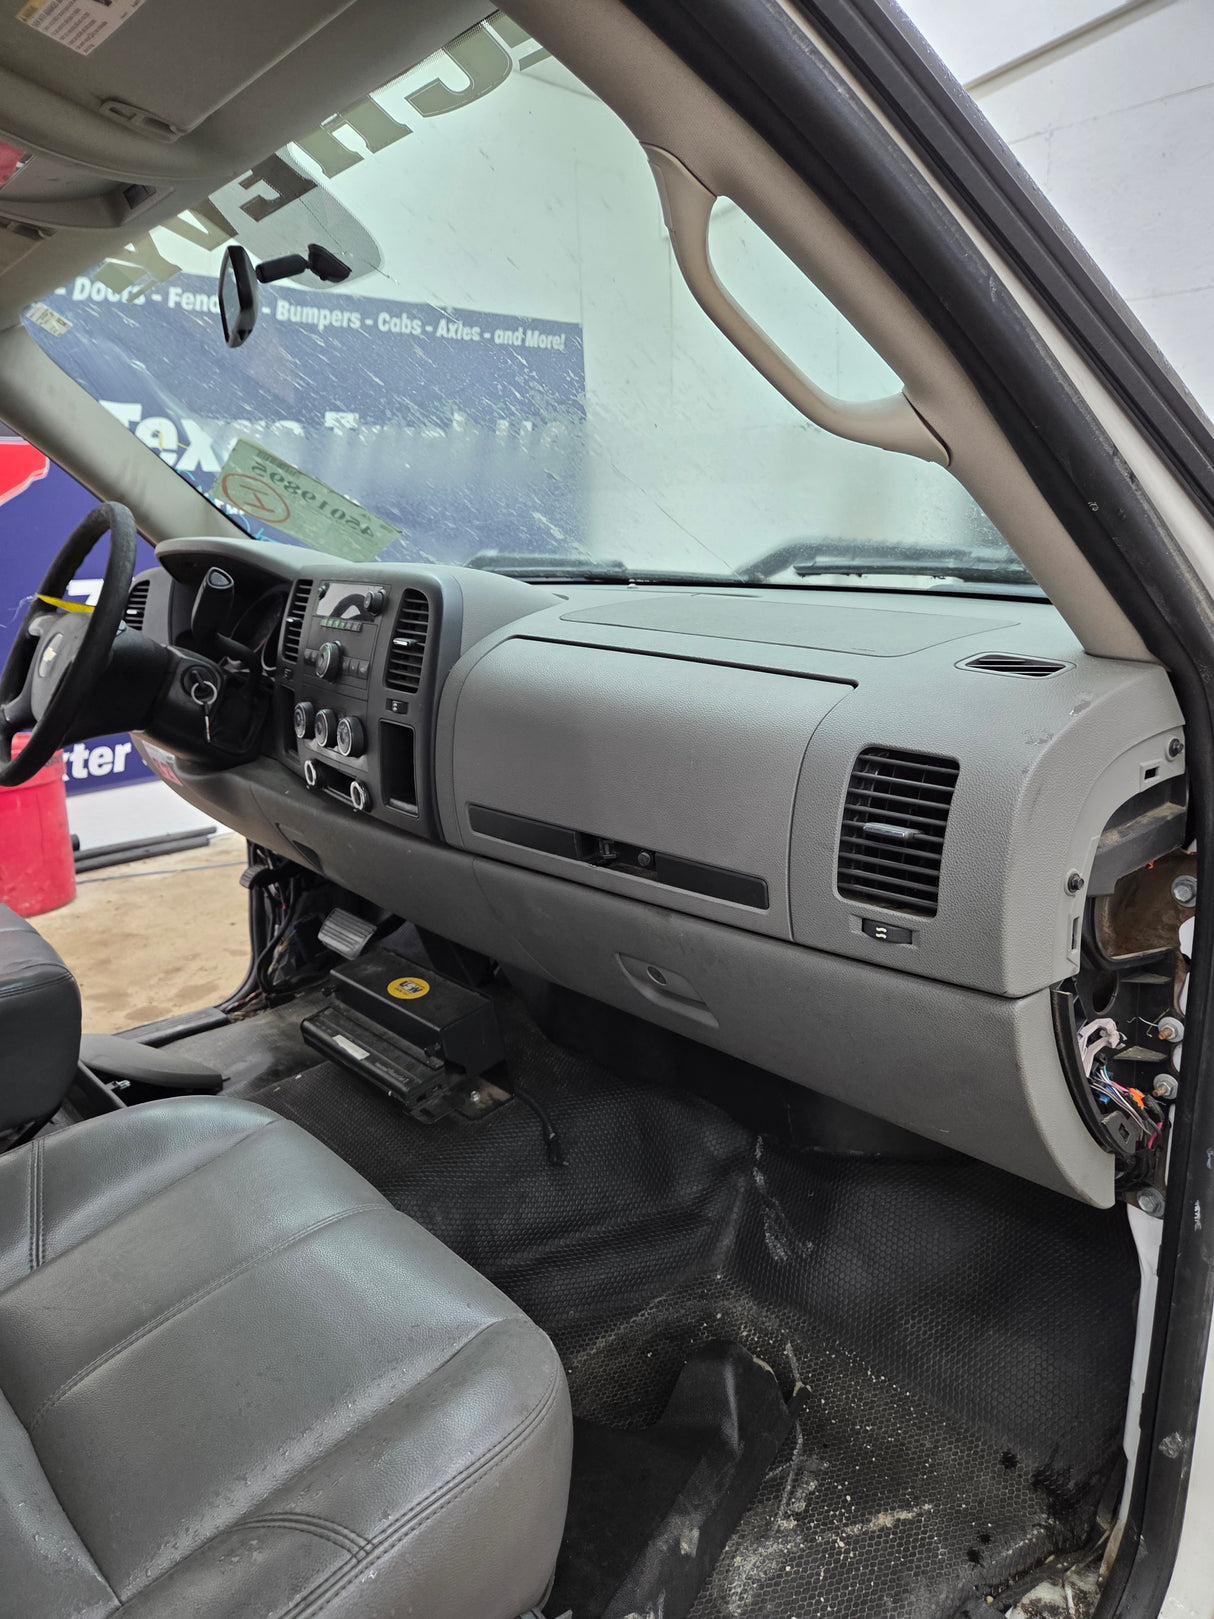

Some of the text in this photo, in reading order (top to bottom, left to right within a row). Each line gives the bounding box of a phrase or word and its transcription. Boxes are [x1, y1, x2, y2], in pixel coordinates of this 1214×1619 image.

[276, 300, 361, 332] Bumpers
[378, 312, 422, 335] Cabs
[436, 319, 481, 341] Axles
[494, 327, 525, 346] and
[525, 330, 566, 350] More!
